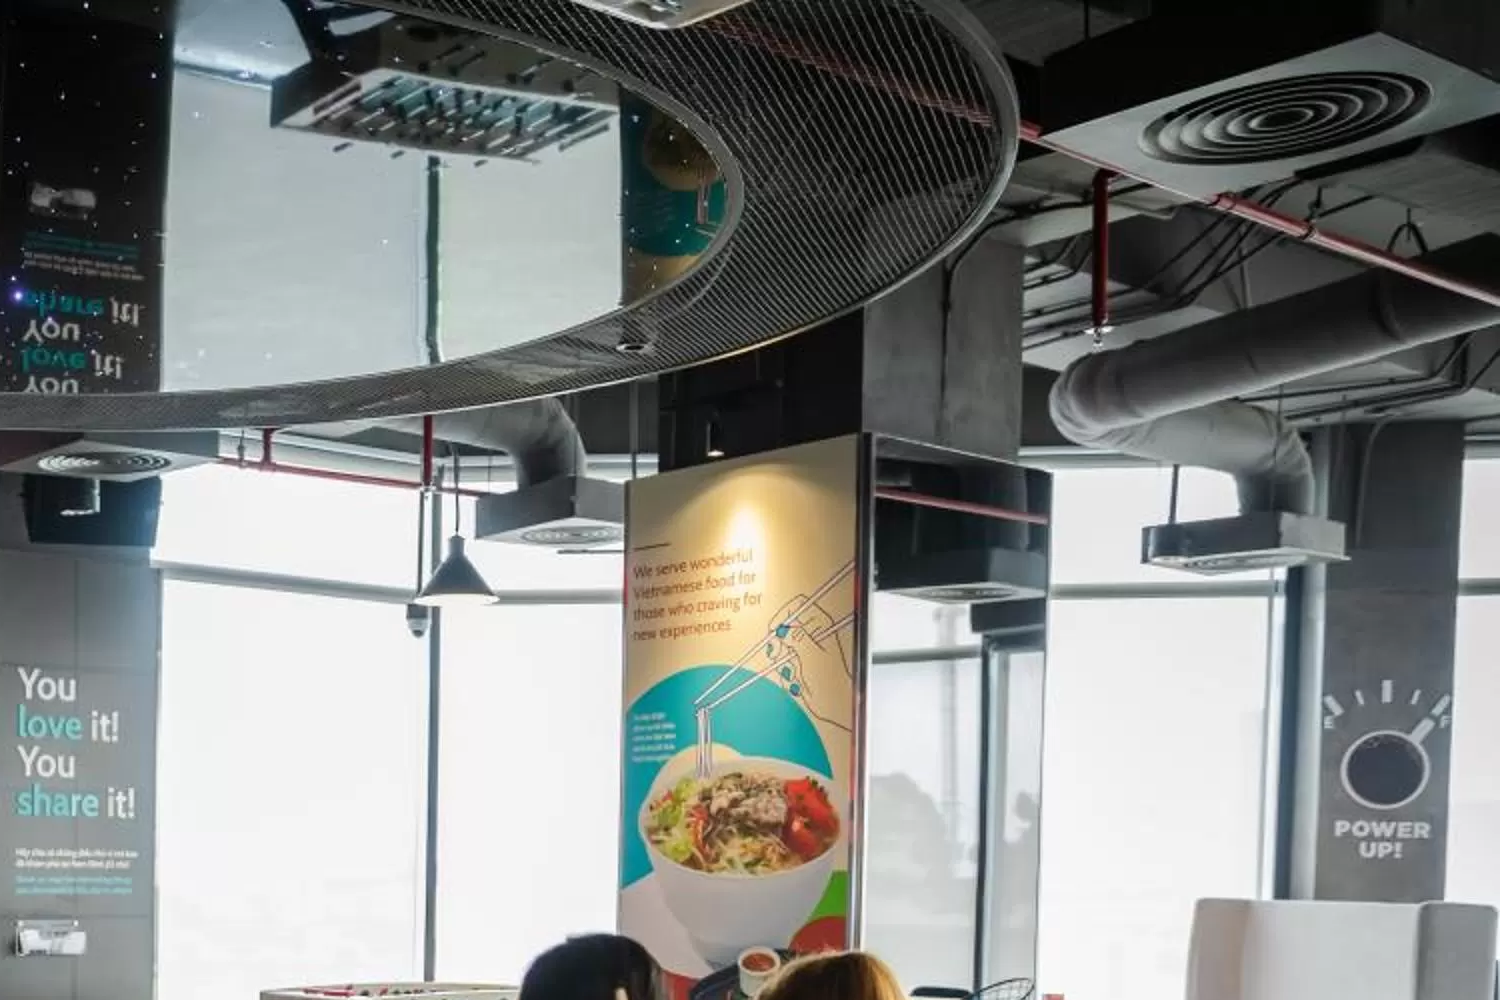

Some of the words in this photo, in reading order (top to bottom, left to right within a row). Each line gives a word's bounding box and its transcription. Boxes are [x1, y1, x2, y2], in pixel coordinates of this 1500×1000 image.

[634, 564, 652, 579] We
[656, 562, 686, 576] serve
[690, 547, 753, 571] wonderful
[706, 573, 735, 590] food
[739, 570, 756, 584] for
[634, 603, 664, 621] those
[668, 600, 693, 616] who
[697, 595, 740, 613] craving
[744, 592, 762, 605] for
[633, 629, 656, 640] new
[660, 618, 732, 640] experiences
[17, 667, 76, 702] You
[17, 704, 83, 739] love
[91, 710, 119, 743] it!
[17, 745, 75, 778] You
[17, 783, 99, 817] share
[108, 787, 136, 818] it!
[1334, 820, 1431, 838] POWER
[1359, 842, 1403, 858] UP!
